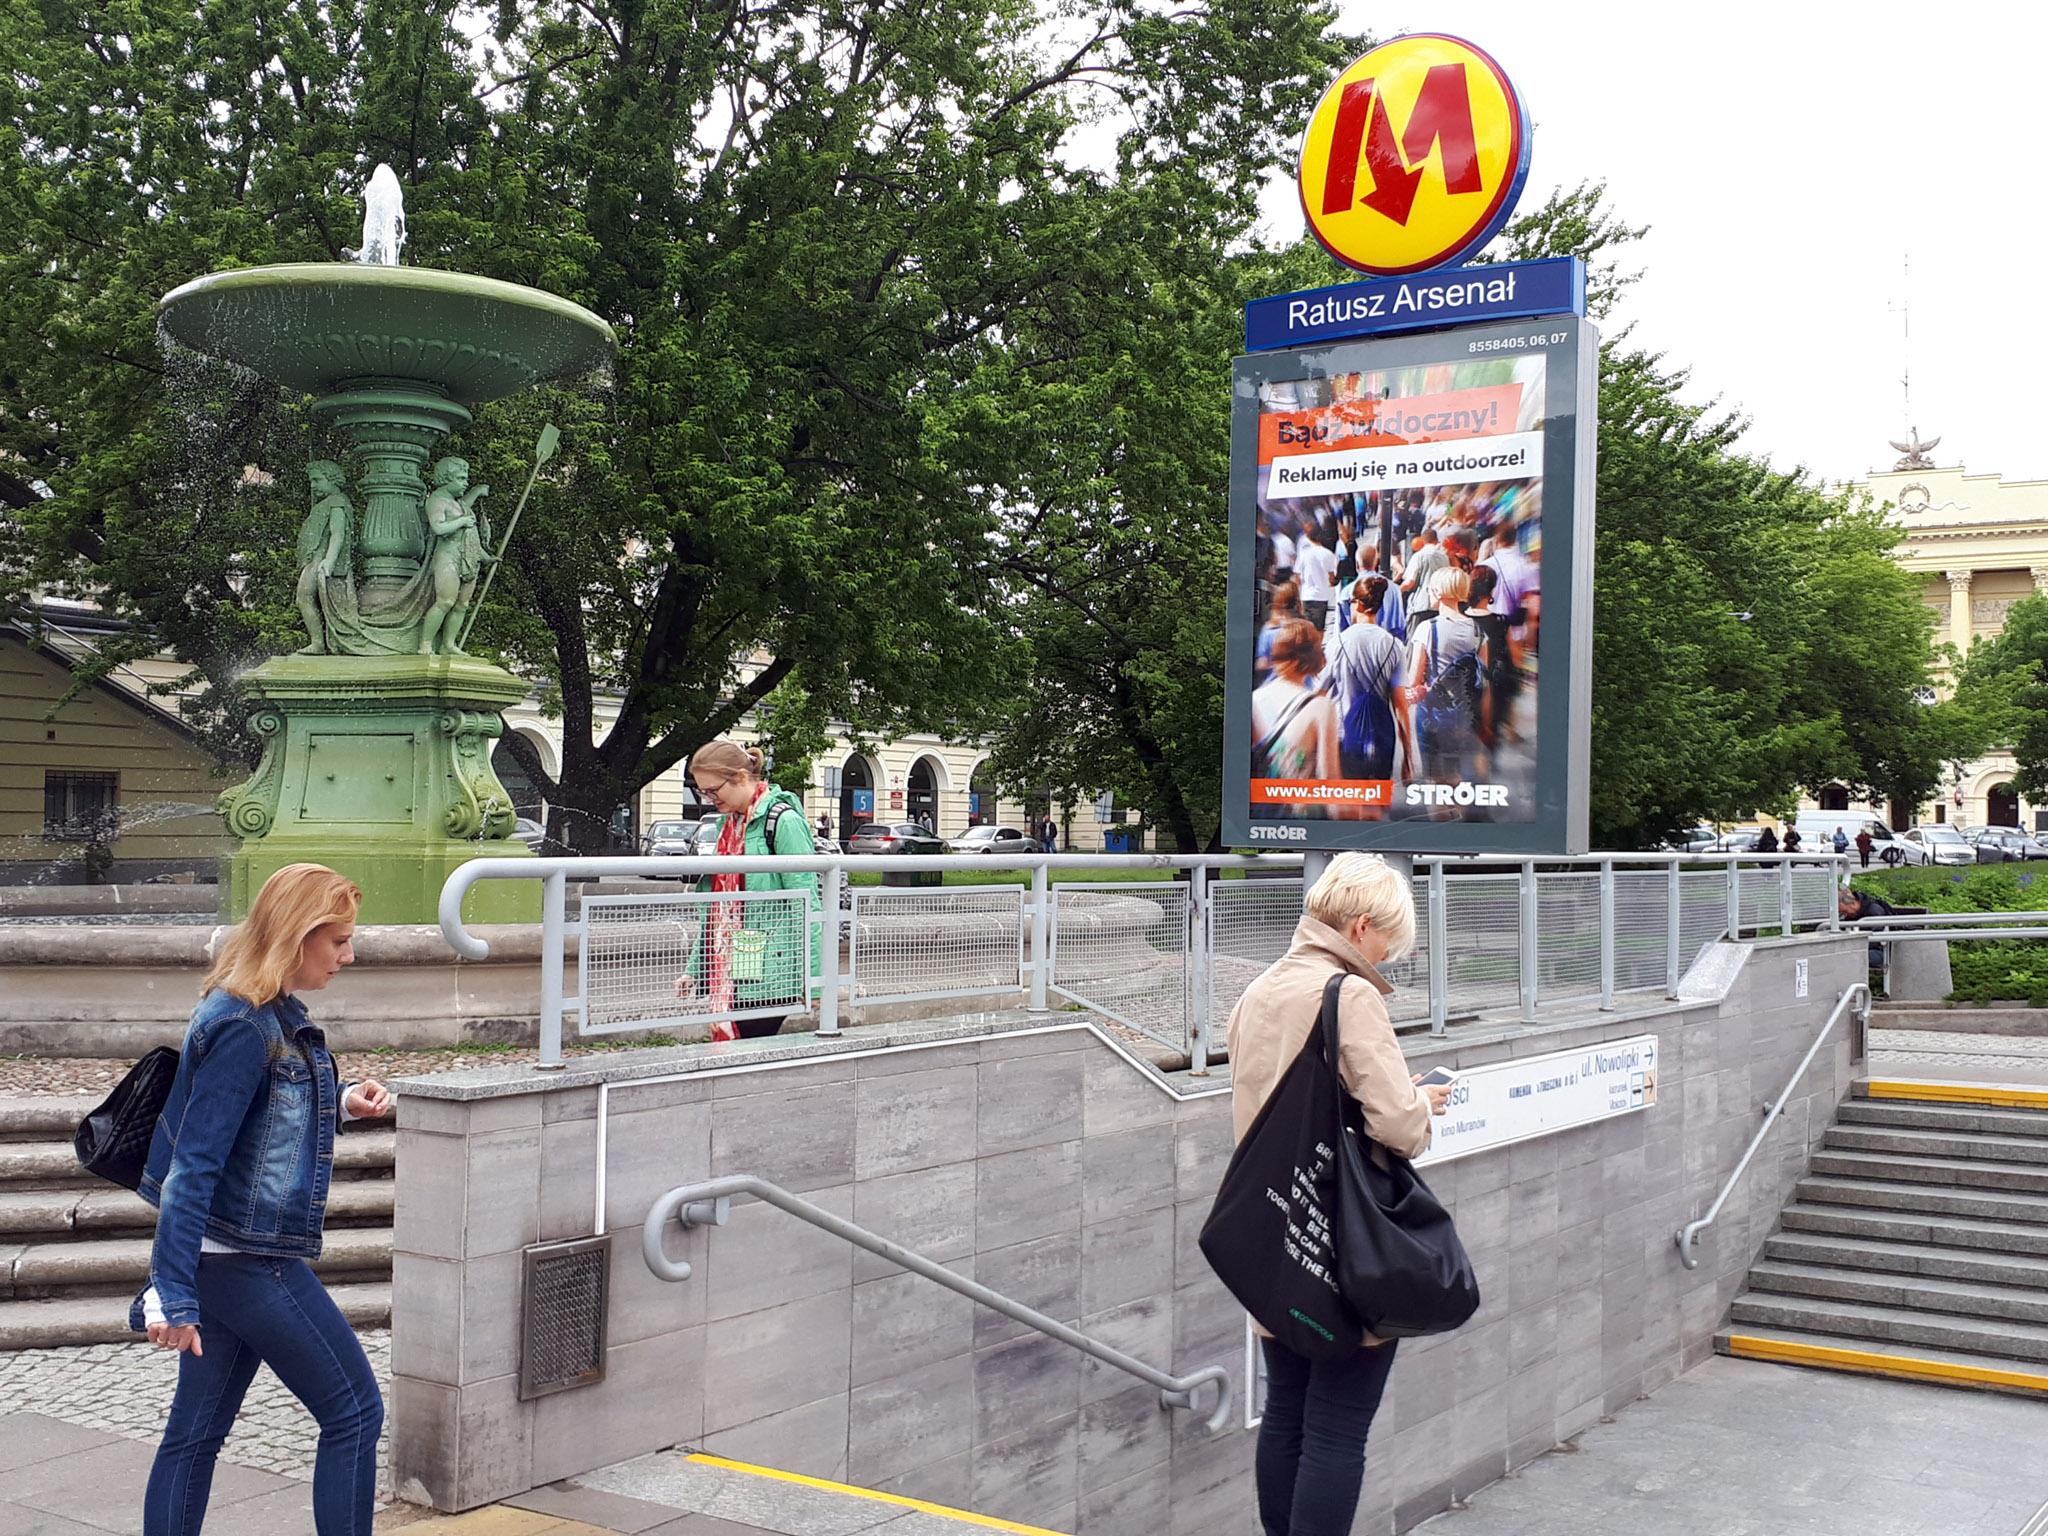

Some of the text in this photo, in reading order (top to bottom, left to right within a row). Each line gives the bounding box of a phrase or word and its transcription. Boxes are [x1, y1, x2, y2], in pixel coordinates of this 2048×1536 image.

[1288, 272, 1517, 330] Ratusz Arsenał
[1351, 401, 1498, 438] widoczny!
[1278, 448, 1525, 484] Reklamuj się na outdoorze!
[860, 795, 866, 811] 5
[1265, 784, 1381, 802] www.stroer.pl
[1581, 1047, 1640, 1078] ul. Nowolipki
[1315, 1142, 1334, 1161] BRI
[1307, 1203, 1331, 1230] WILL
[1306, 1220, 1322, 1238] BE
[1300, 1235, 1321, 1256] CAN
[1301, 1254, 1325, 1277] THE
